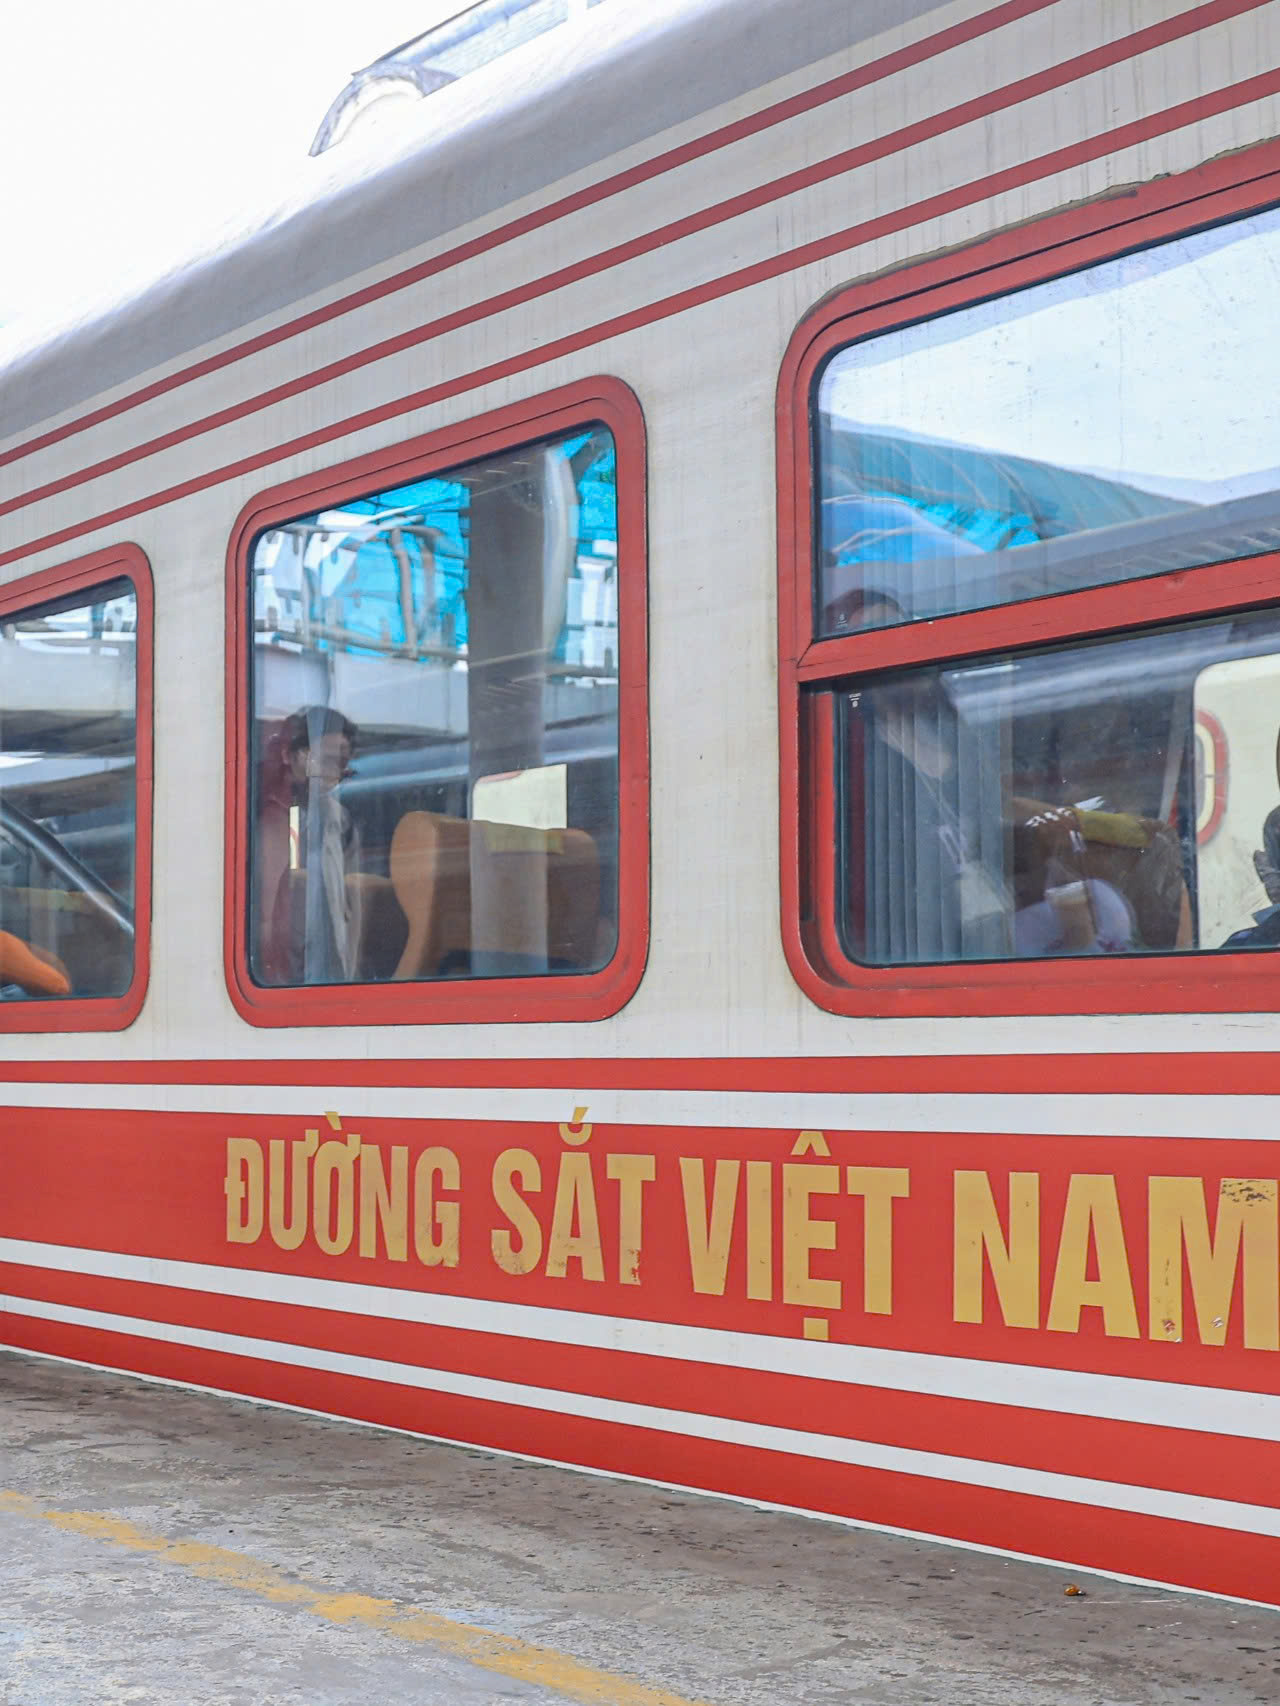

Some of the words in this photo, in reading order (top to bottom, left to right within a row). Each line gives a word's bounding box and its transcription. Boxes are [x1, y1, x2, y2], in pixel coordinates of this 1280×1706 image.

[224, 1111, 461, 1268] ĐƯỜNG
[491, 1107, 656, 1286] SẮT
[679, 1130, 910, 1341] VIỆT
[953, 1170, 1280, 1352] NAM
